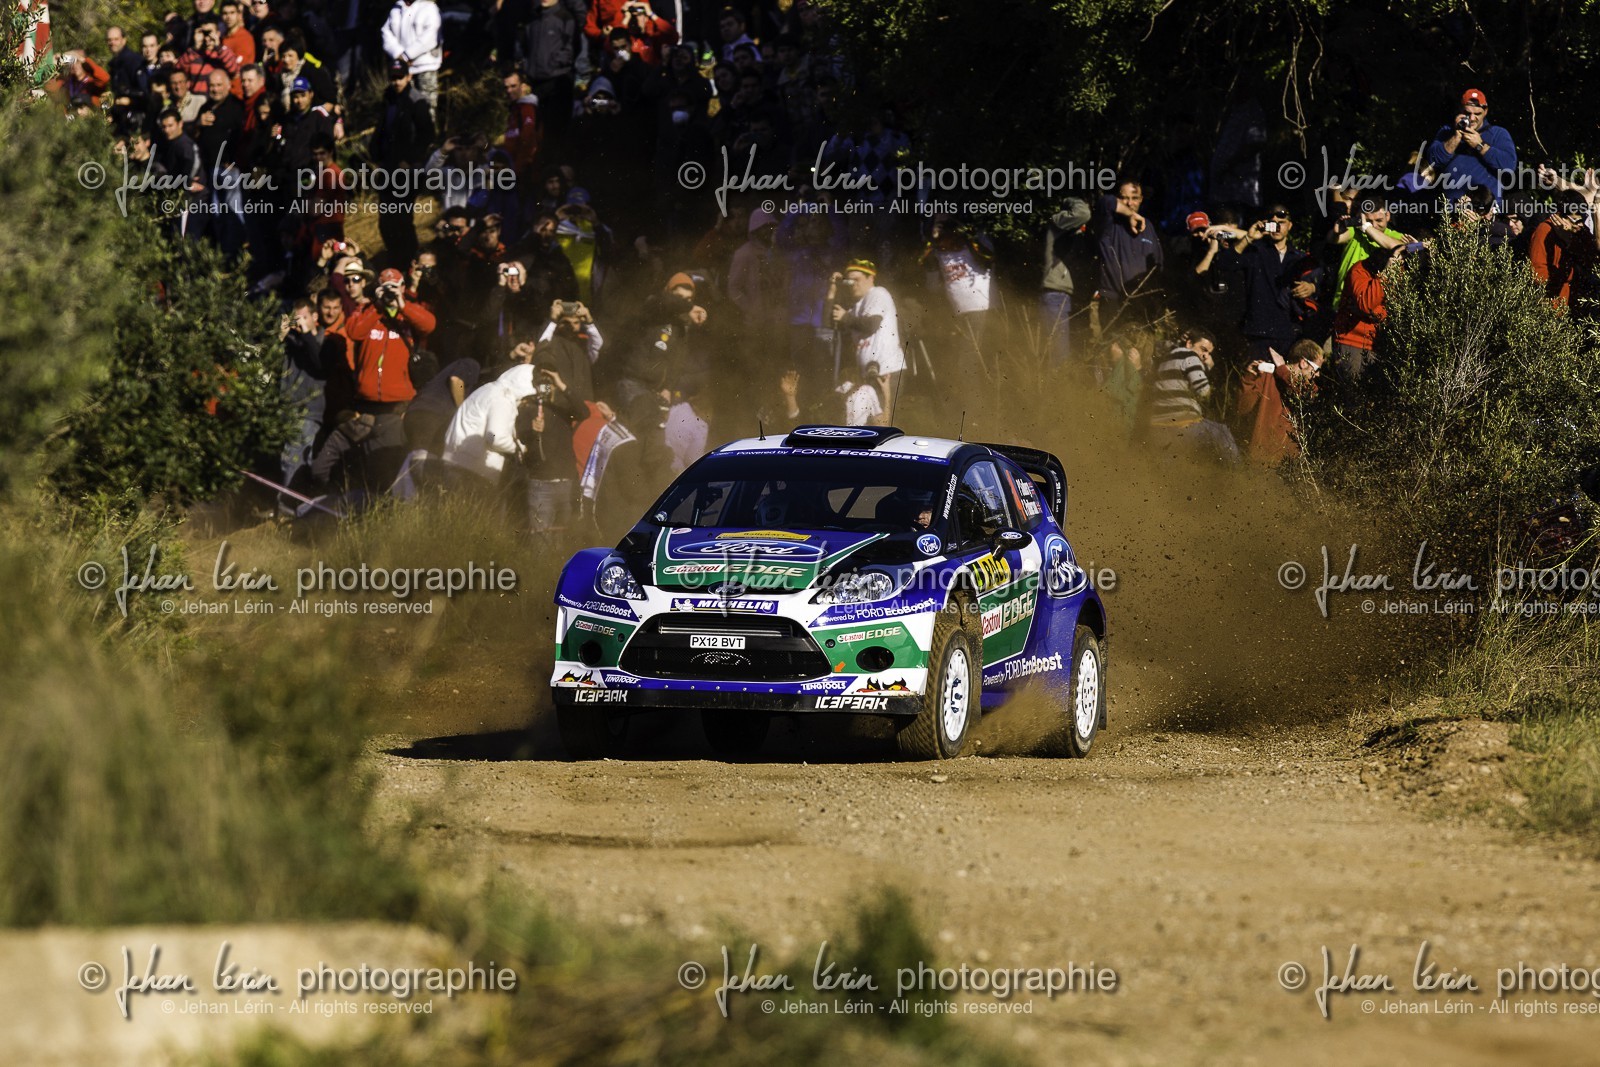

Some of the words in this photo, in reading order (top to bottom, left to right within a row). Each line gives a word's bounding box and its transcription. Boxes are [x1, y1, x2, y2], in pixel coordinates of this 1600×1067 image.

[808, 427, 863, 438] Ford
[838, 449, 920, 461] EcoBoost
[700, 540, 800, 555] Ford
[922, 537, 940, 553] Ford
[676, 563, 721, 573] Castrol
[724, 563, 809, 577] EDGE
[583, 600, 600, 611] FORD
[599, 602, 632, 618] EcoBoost
[696, 599, 773, 611] MICHELIN
[857, 606, 885, 619] FORD
[885, 597, 936, 616] EcoBoost
[981, 608, 1001, 636] Castrol
[1002, 590, 1034, 629] EDGE
[593, 623, 617, 636] EDGE
[844, 632, 864, 642] Castrol
[866, 626, 902, 640] EDGE
[692, 637, 717, 647] PX12
[720, 637, 744, 648] BVT
[1005, 659, 1022, 681] FORD
[1021, 651, 1063, 676] EcoBoost
